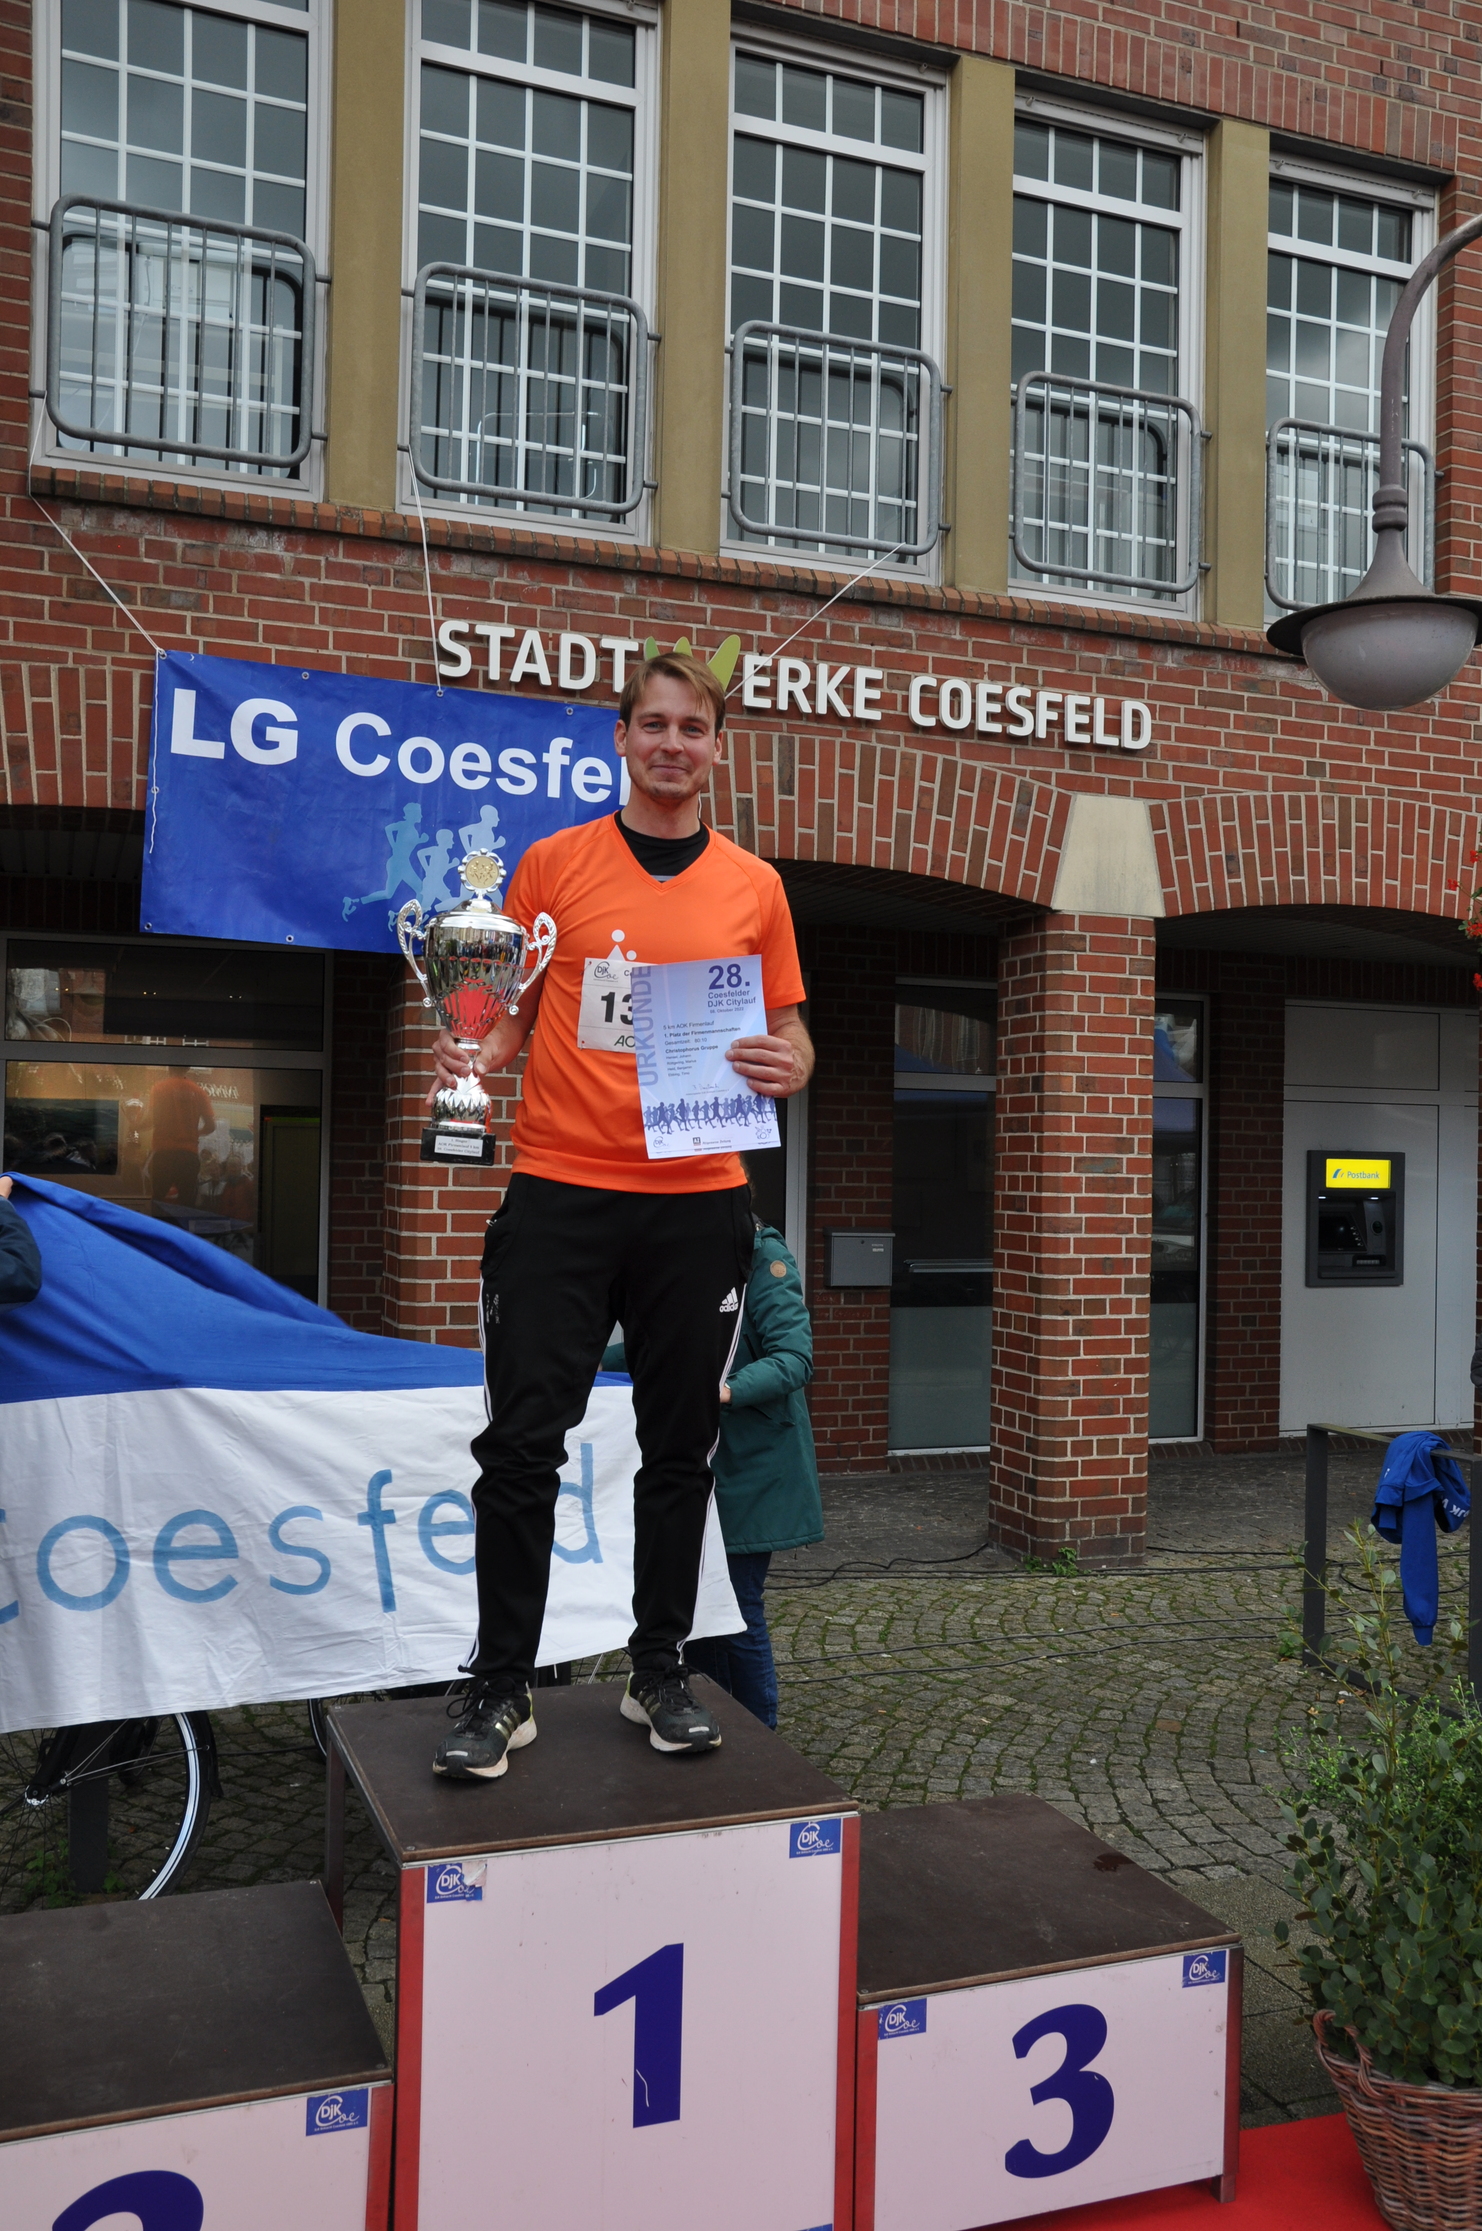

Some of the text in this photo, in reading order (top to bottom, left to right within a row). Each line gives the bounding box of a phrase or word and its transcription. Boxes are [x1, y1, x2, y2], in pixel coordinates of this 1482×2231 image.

[909, 676, 1152, 750] COESFELD
[170, 688, 632, 806] LG Coesfel
[708, 990, 750, 999] Coesfelder
[709, 963, 750, 990] 28.
[632, 966, 659, 1087] URKUNDE
[708, 997, 756, 1008] DJK Citylauf
[614, 1035, 636, 1048] AO
[691, 1027, 741, 1035] Firmenmannschaften
[1347, 1171, 1380, 1179] Postbank
[0, 1443, 603, 1624] oesfed
[594, 1943, 684, 2129] 1
[1005, 2004, 1115, 2179] 3
